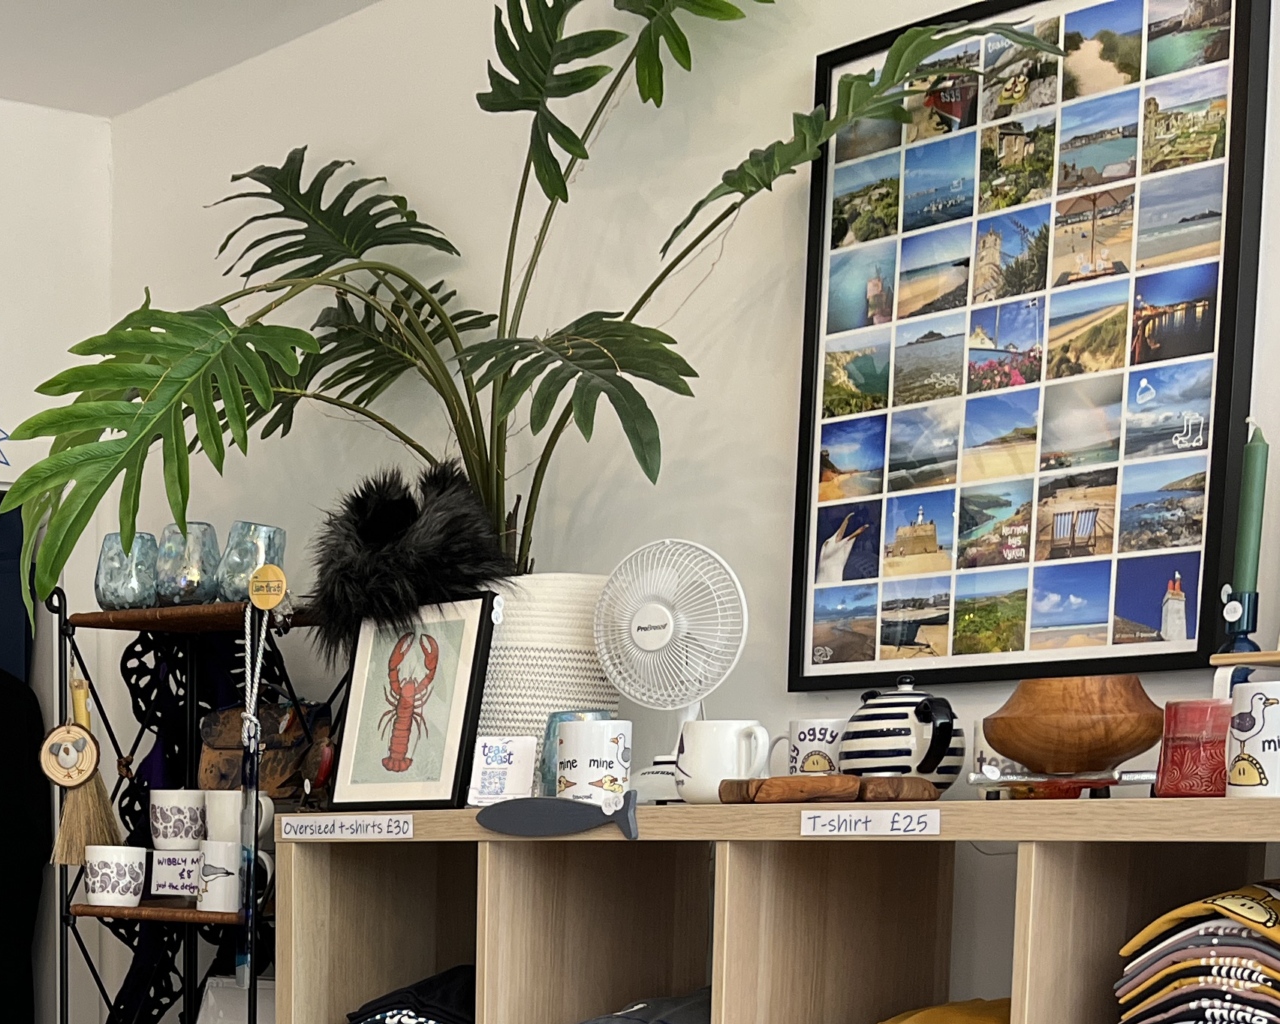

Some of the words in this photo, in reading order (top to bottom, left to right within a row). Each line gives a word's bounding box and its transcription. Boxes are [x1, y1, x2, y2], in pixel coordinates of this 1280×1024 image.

[798, 727, 839, 744] oggy
[482, 742, 508, 757] tea&
[485, 751, 514, 766] coast
[559, 758, 578, 771] mine
[588, 758, 615, 770] mine
[789, 744, 800, 775] ggy
[283, 819, 336, 836] Oversized
[338, 819, 383, 835] t-shirts
[386, 818, 410, 836] £30
[807, 813, 872, 833] T-shirt
[890, 812, 928, 833] £25
[157, 857, 188, 867] WIBBLY
[179, 868, 194, 879] £8
[155, 881, 167, 891] just
[167, 881, 179, 890] the
